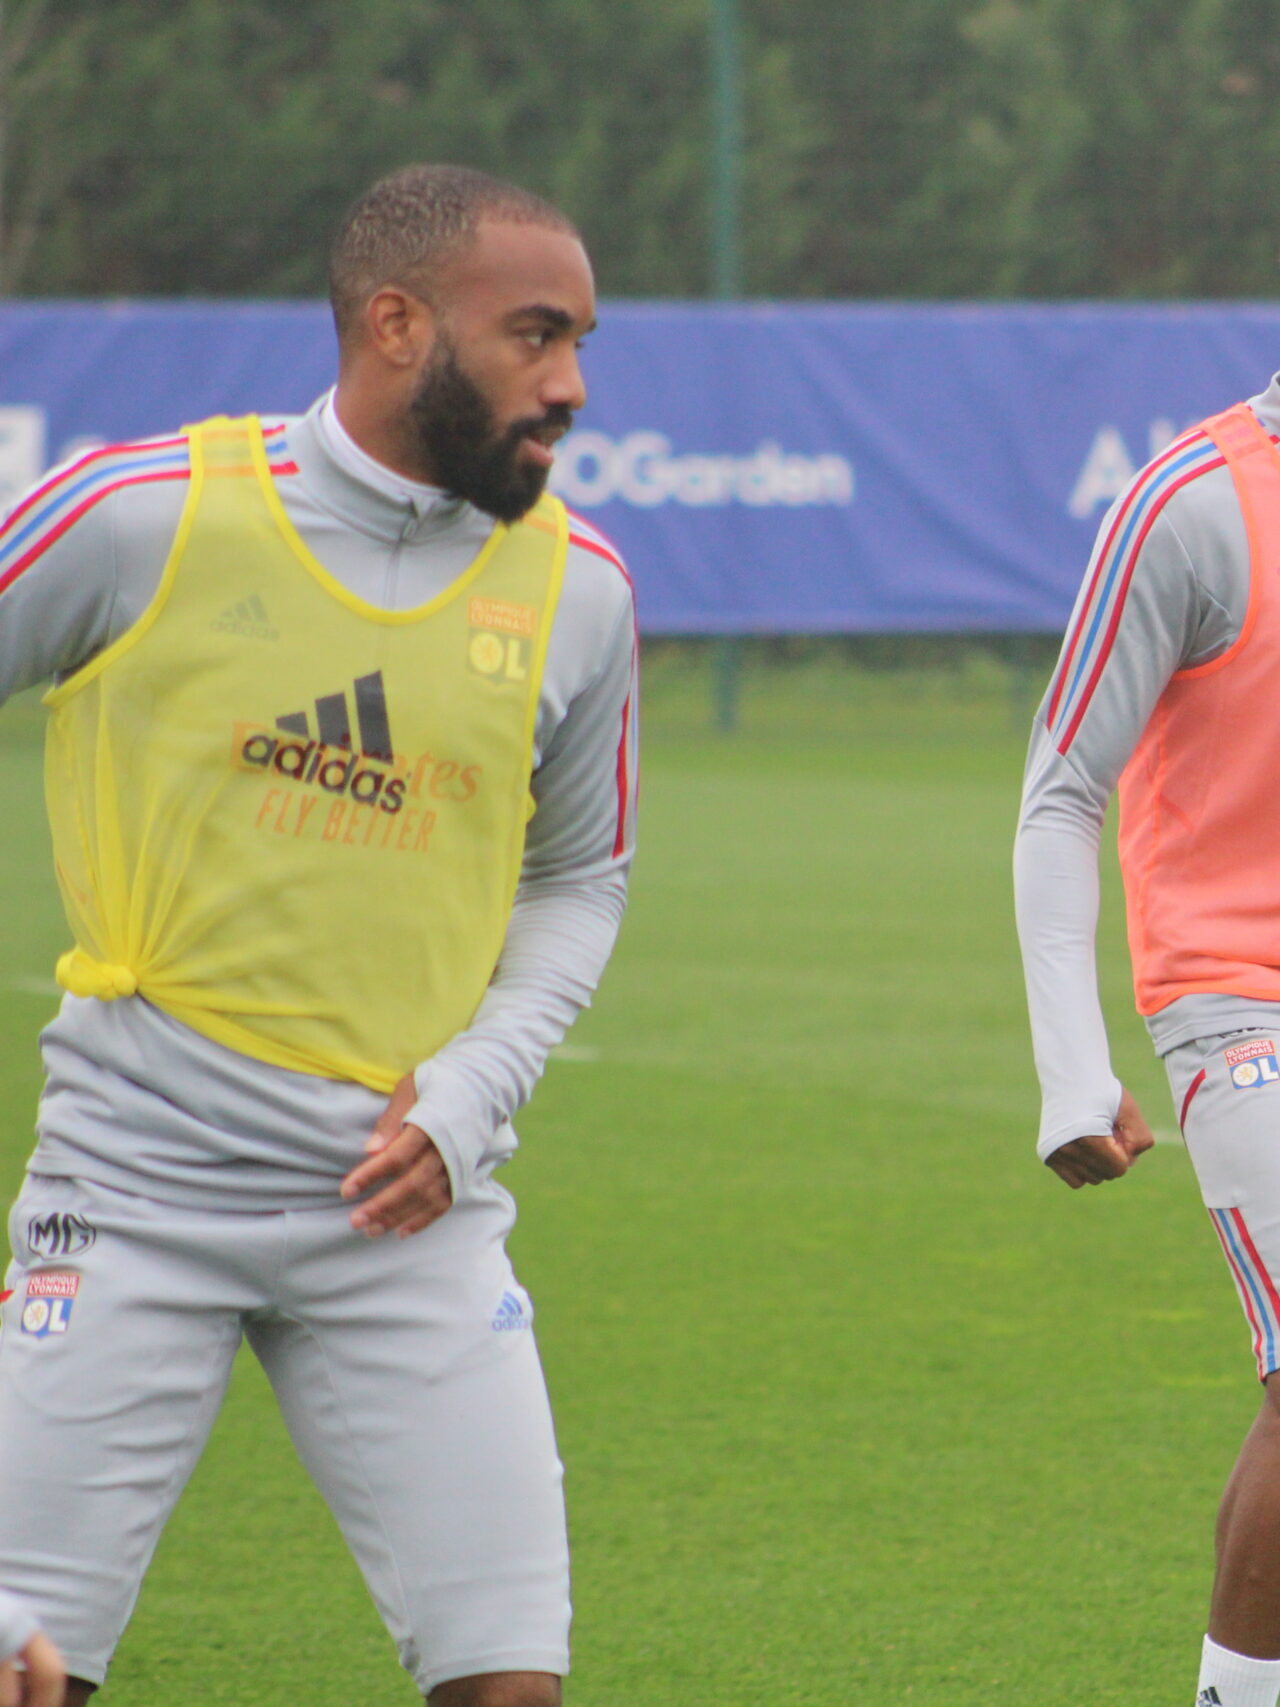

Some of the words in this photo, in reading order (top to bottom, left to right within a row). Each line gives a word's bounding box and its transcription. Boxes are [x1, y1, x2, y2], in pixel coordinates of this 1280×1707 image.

[550, 430, 854, 507] OGarden
[469, 632, 528, 681] OL
[242, 732, 407, 817] adidas
[254, 787, 318, 839] FLY
[320, 797, 439, 854] BETTER
[1225, 1041, 1270, 1058] OLYMPIQUE
[1227, 1046, 1273, 1066] LYONNAIS
[1232, 1057, 1280, 1087] OL
[28, 1283, 76, 1296] LYONNAIS
[23, 1299, 68, 1332] OL
